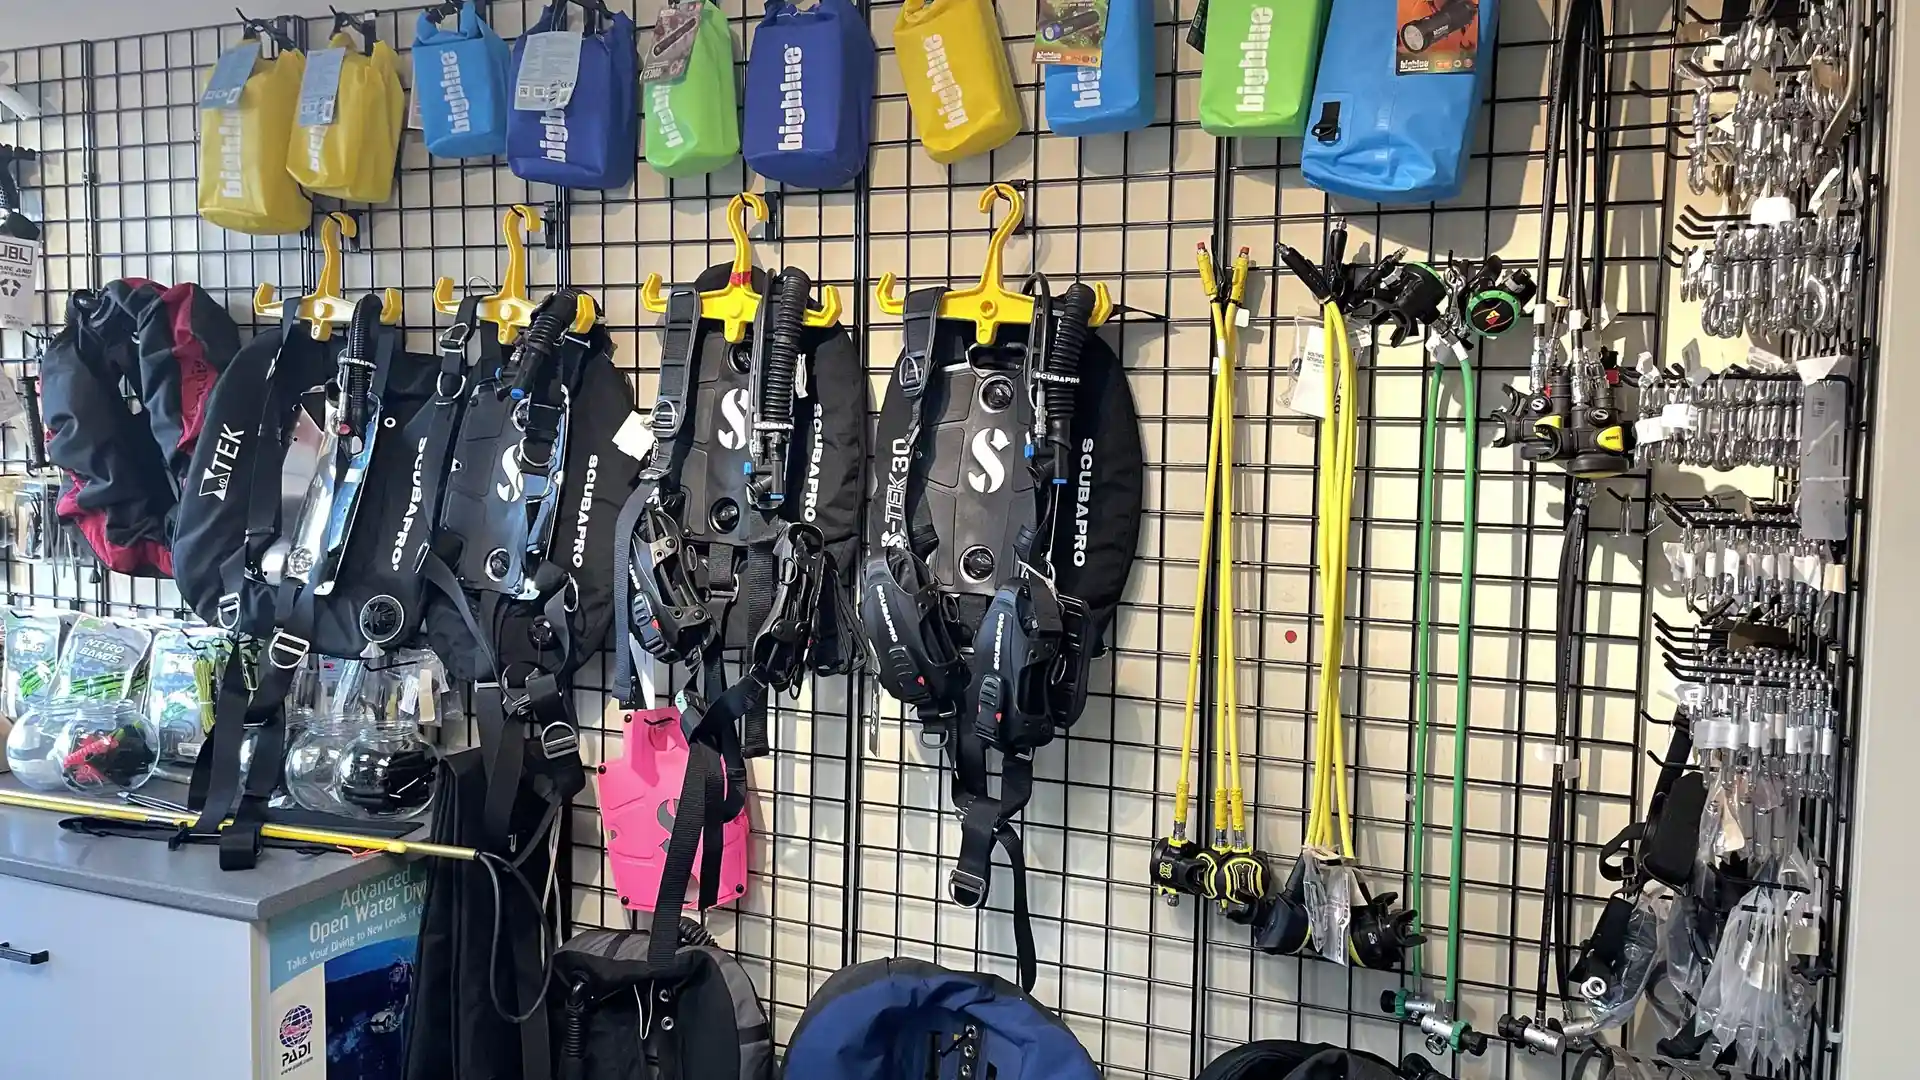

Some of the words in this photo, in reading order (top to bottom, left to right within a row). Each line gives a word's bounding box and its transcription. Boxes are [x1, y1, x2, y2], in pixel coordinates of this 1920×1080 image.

[441, 50, 471, 134] bigblue
[923, 33, 969, 131] bigblue
[1236, 6, 1274, 112] bigblue
[778, 45, 806, 151] bigblue
[803, 402, 823, 523] SCUBAPRO
[392, 436, 427, 566] SCUBAPRO
[572, 453, 599, 568] SCUBAPRO
[1073, 437, 1094, 567] SCUBAPRO
[83, 638, 125, 654] NITRO
[877, 584, 899, 643] SCUBAPRO
[993, 612, 1005, 671] SCUBAPRO
[79, 647, 123, 664] BANDS
[309, 914, 349, 945] Open
[355, 893, 400, 924] Water
[340, 863, 411, 911] Advanced
[286, 955, 308, 972] Take
[309, 945, 328, 960] Your
[331, 935, 355, 952] Diving
[357, 931, 365, 941] to
[367, 923, 382, 937] New
[385, 912, 407, 931] Levels
[282, 1041, 311, 1067] PADI
